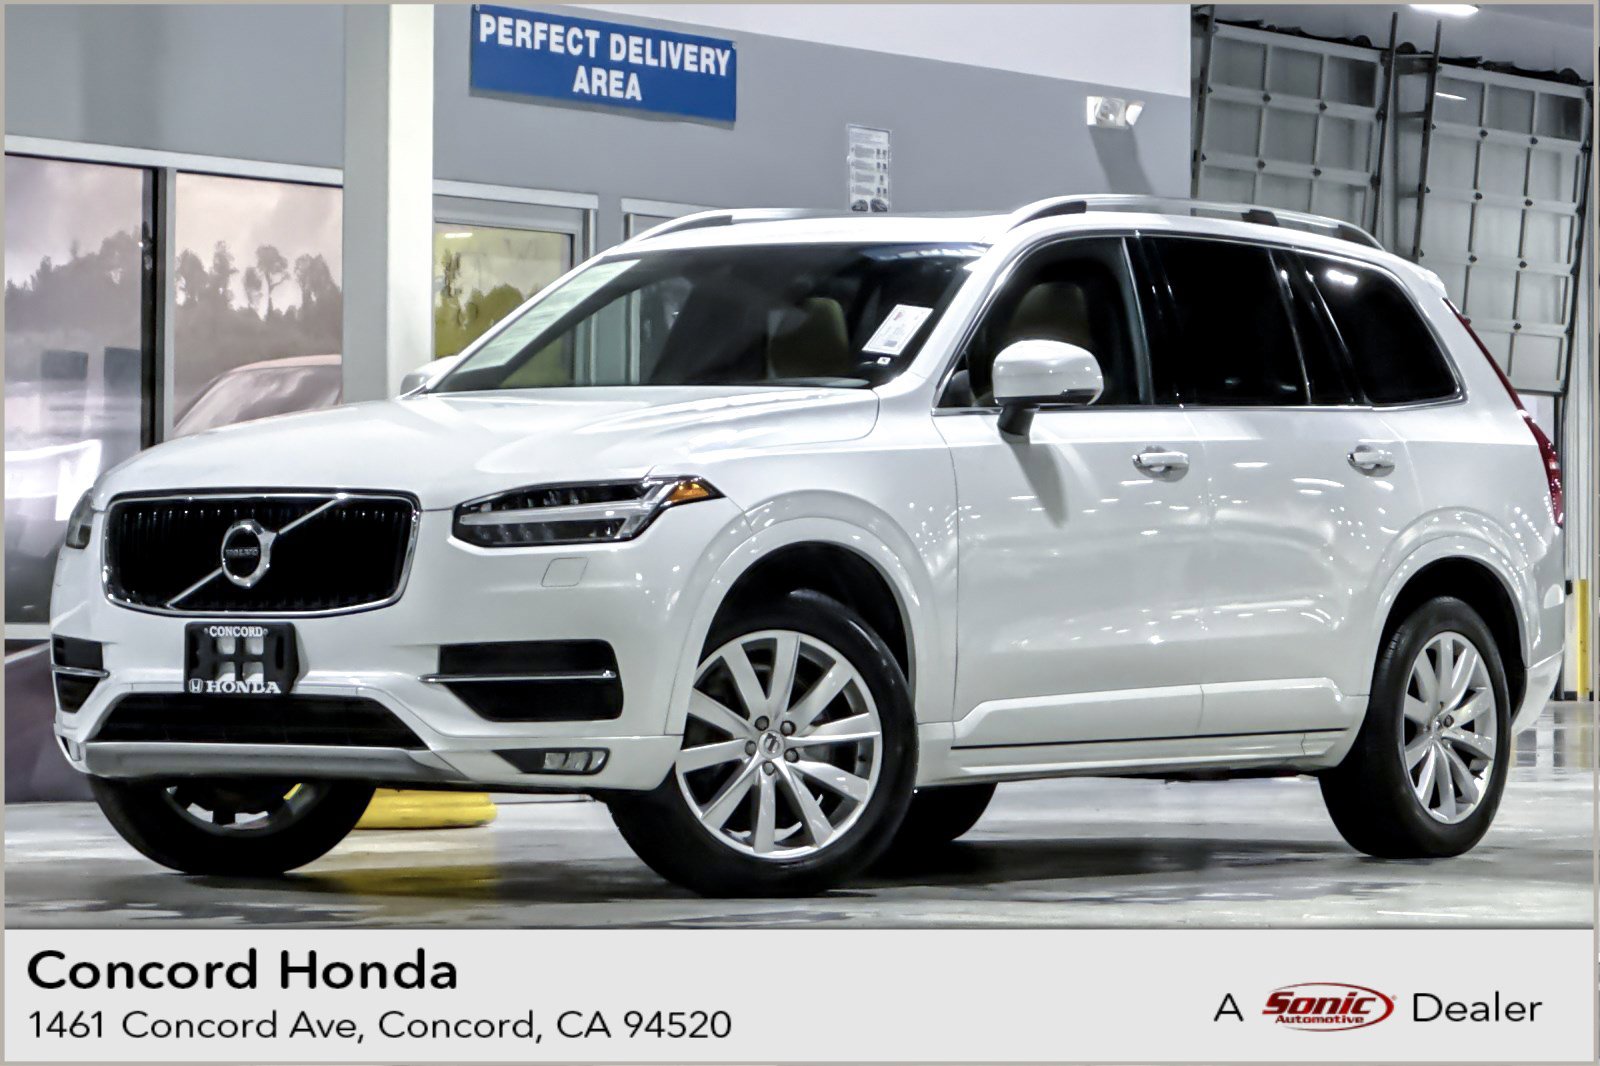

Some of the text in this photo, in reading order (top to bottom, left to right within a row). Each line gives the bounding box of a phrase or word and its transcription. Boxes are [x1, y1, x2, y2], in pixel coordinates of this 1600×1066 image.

[479, 13, 731, 76] PERFECT DELIVERY
[572, 65, 643, 101] AREA
[209, 626, 264, 638] CONCORD
[206, 681, 281, 694] HONDA
